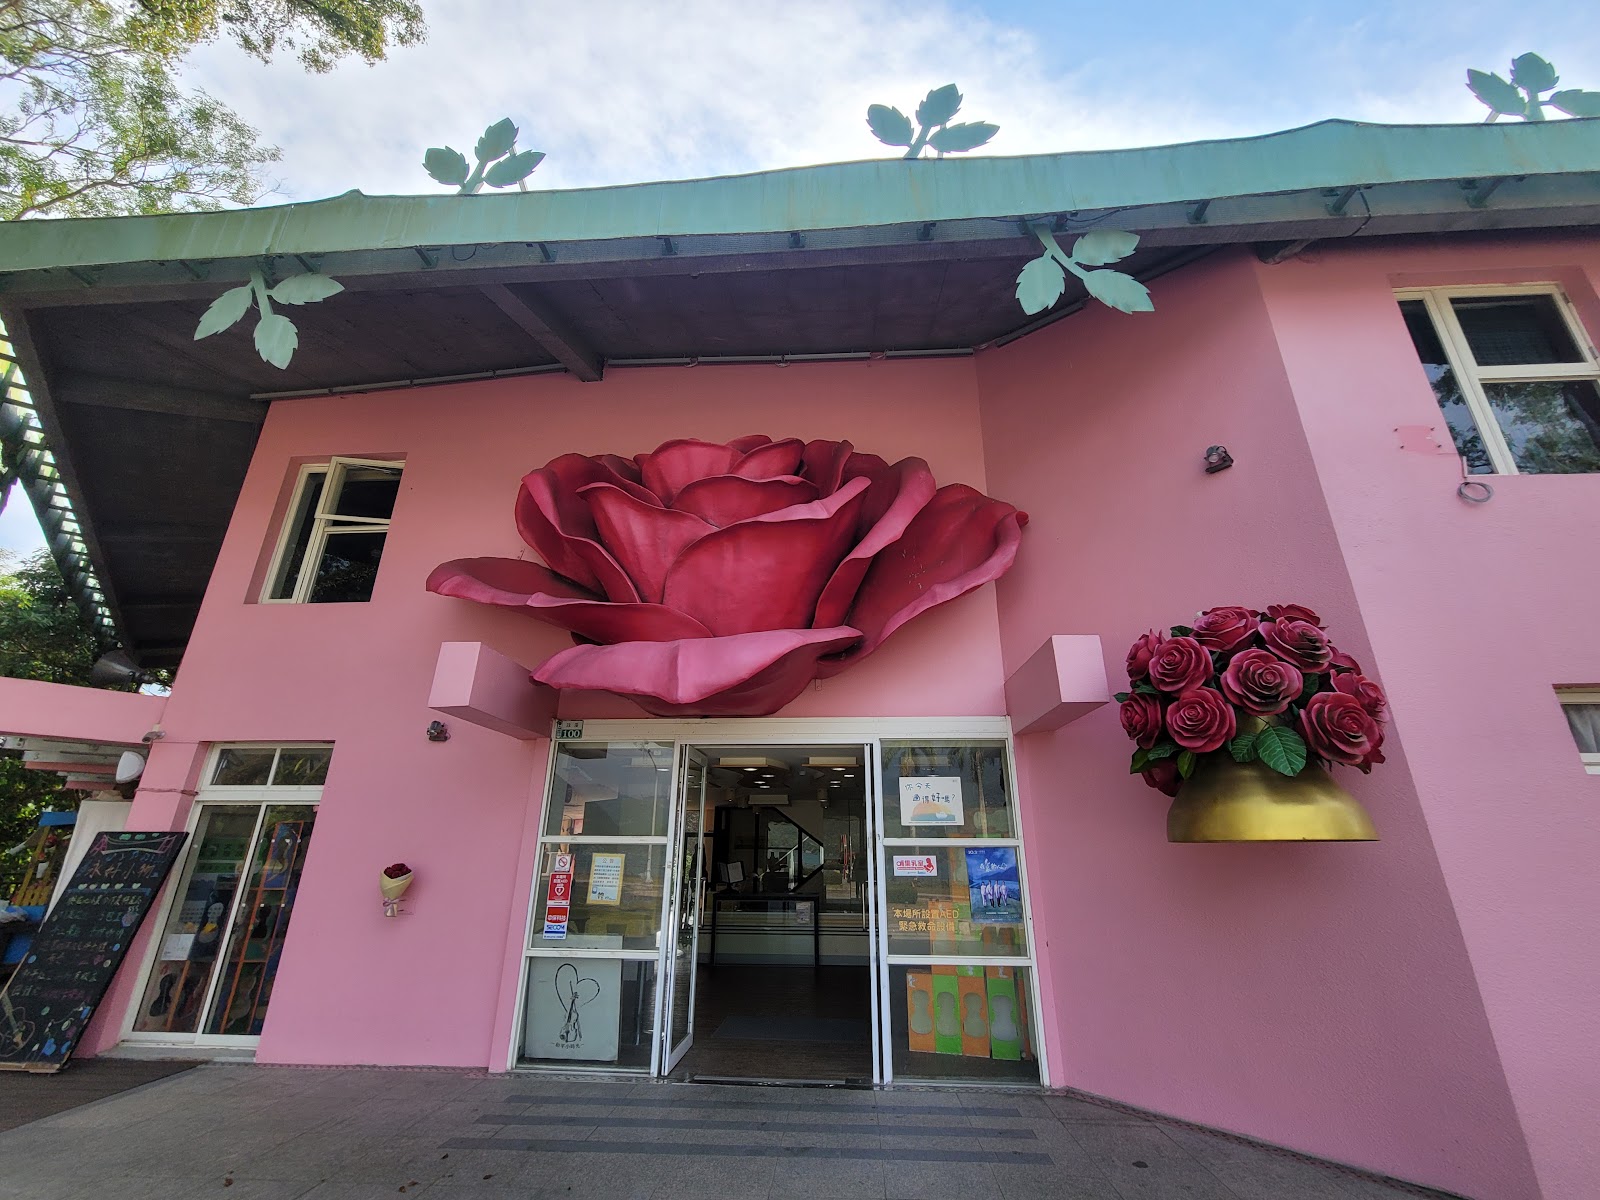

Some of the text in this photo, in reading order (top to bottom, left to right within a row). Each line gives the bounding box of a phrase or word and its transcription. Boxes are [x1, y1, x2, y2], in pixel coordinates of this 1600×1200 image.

[562, 730, 580, 738] 100
[905, 782, 931, 791] 你今天
[893, 908, 959, 919] 本場所設置AED
[898, 920, 955, 932] 緊急救命設備
